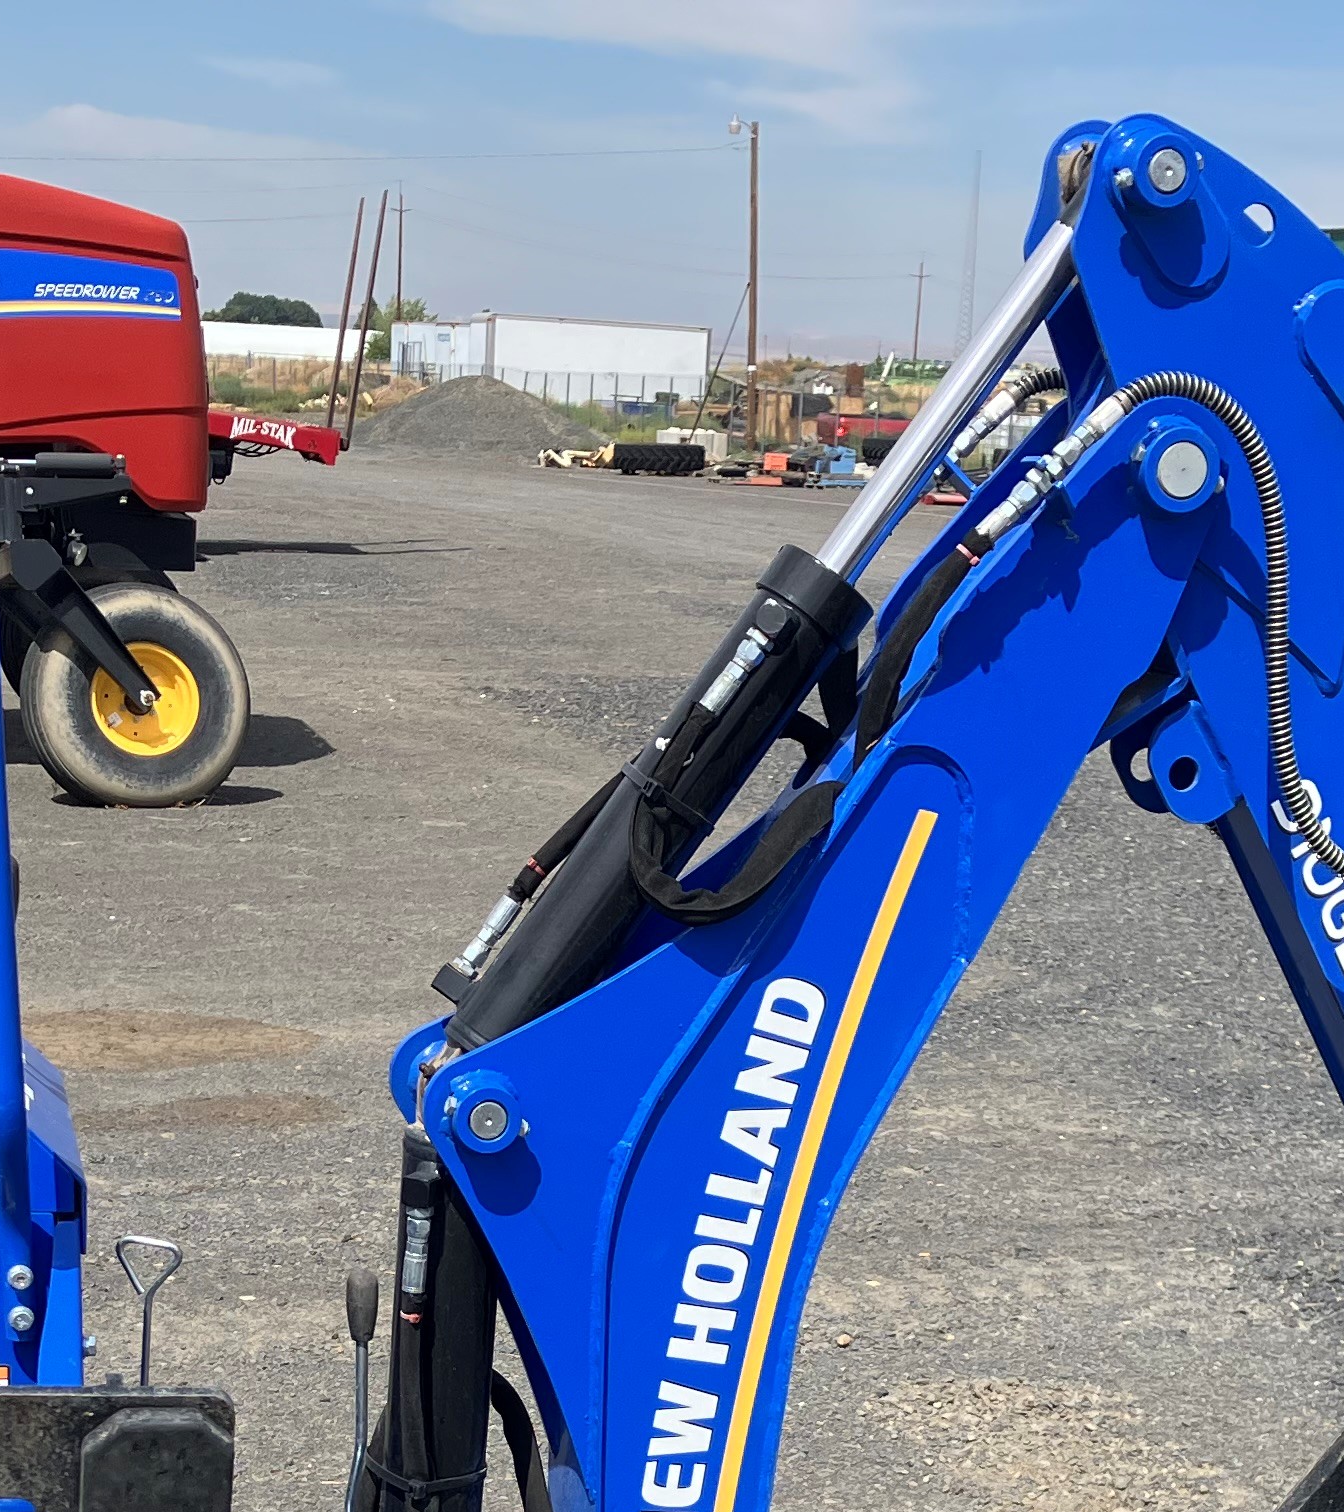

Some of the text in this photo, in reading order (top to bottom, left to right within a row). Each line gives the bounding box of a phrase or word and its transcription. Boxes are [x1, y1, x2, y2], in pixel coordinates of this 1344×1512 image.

[34, 283, 141, 300] SPEEDROWER
[229, 416, 297, 449] MIL-STAK
[666, 976, 828, 1365] HOLLAND
